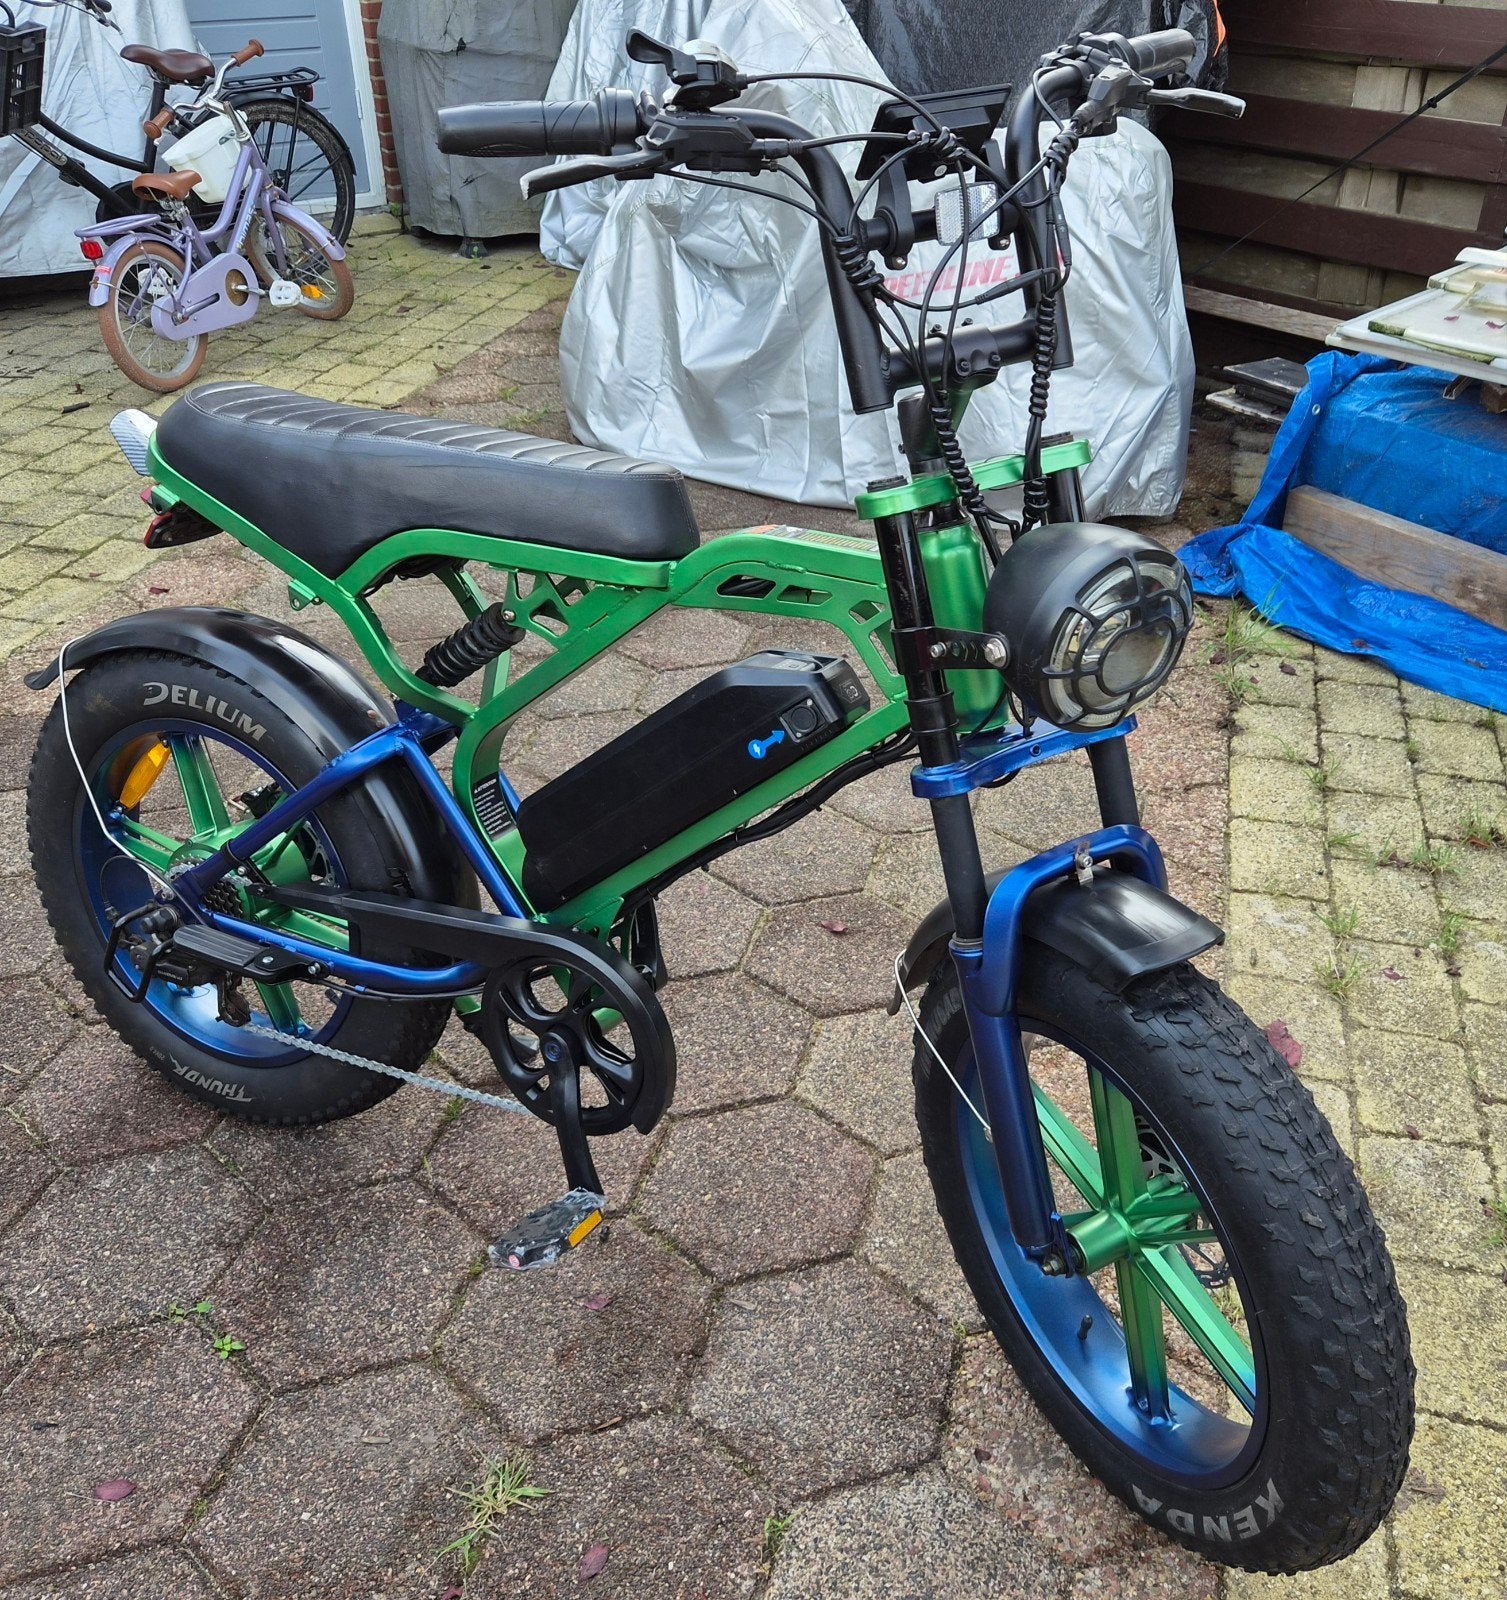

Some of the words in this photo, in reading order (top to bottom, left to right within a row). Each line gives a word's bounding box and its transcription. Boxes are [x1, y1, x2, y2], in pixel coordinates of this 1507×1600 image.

[877, 255, 1014, 303] PEEDLINE
[142, 681, 268, 742] DELIUM
[168, 1053, 253, 1103] THUNDR
[1132, 1477, 1285, 1542] KENDA
